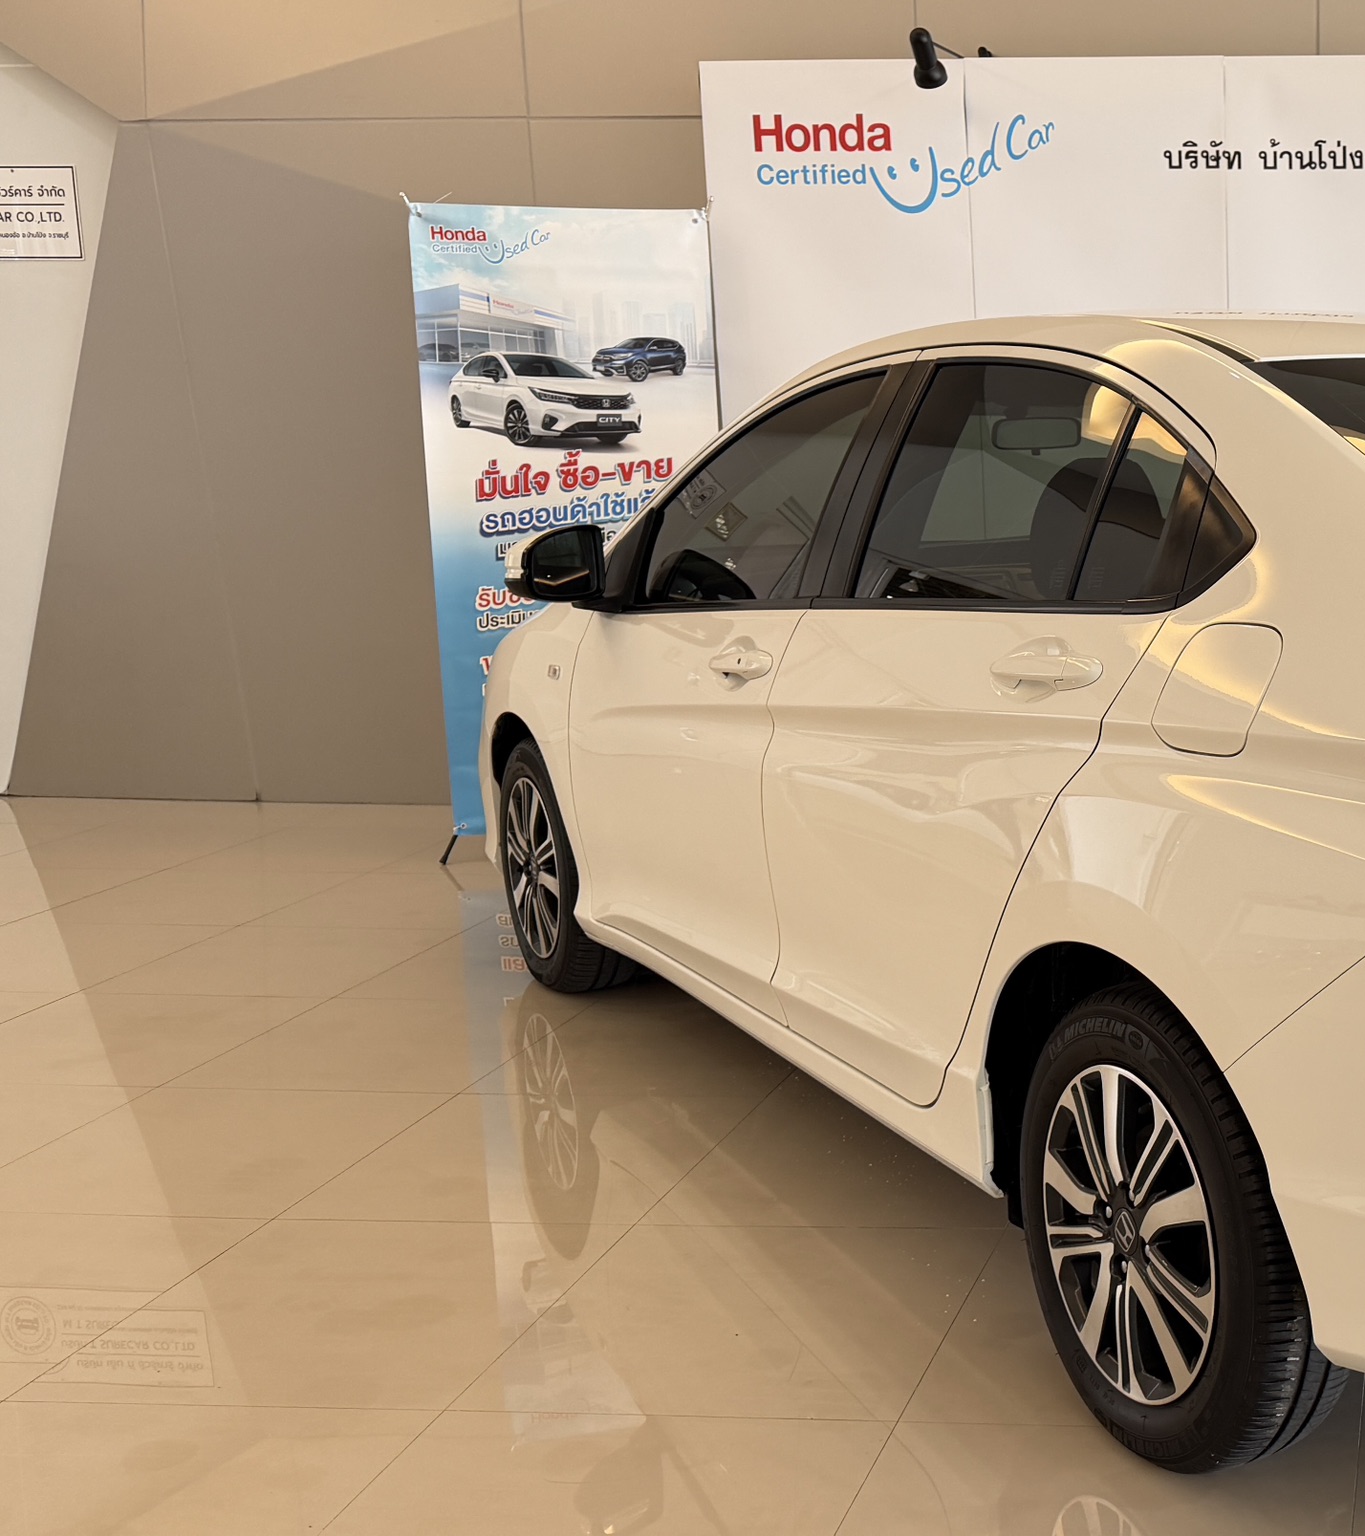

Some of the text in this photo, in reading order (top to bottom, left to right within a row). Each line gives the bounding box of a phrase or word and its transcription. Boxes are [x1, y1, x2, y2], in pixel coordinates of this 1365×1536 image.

[752, 113, 892, 153] Honda
[756, 164, 867, 185] Certified
[1005, 114, 1056, 160] Car
[1163, 139, 1243, 170] บริษัท
[1258, 138, 1365, 171] บ้านโป่ง
[37, 184, 65, 197] จำกัด
[430, 225, 487, 242] Honda
[432, 244, 478, 254] Certified
[531, 228, 551, 246] Car
[477, 459, 551, 500] มั่นใจ
[559, 449, 674, 490] ซื้อ-ขาย
[1064, 1017, 1125, 1042] MICHELIN
